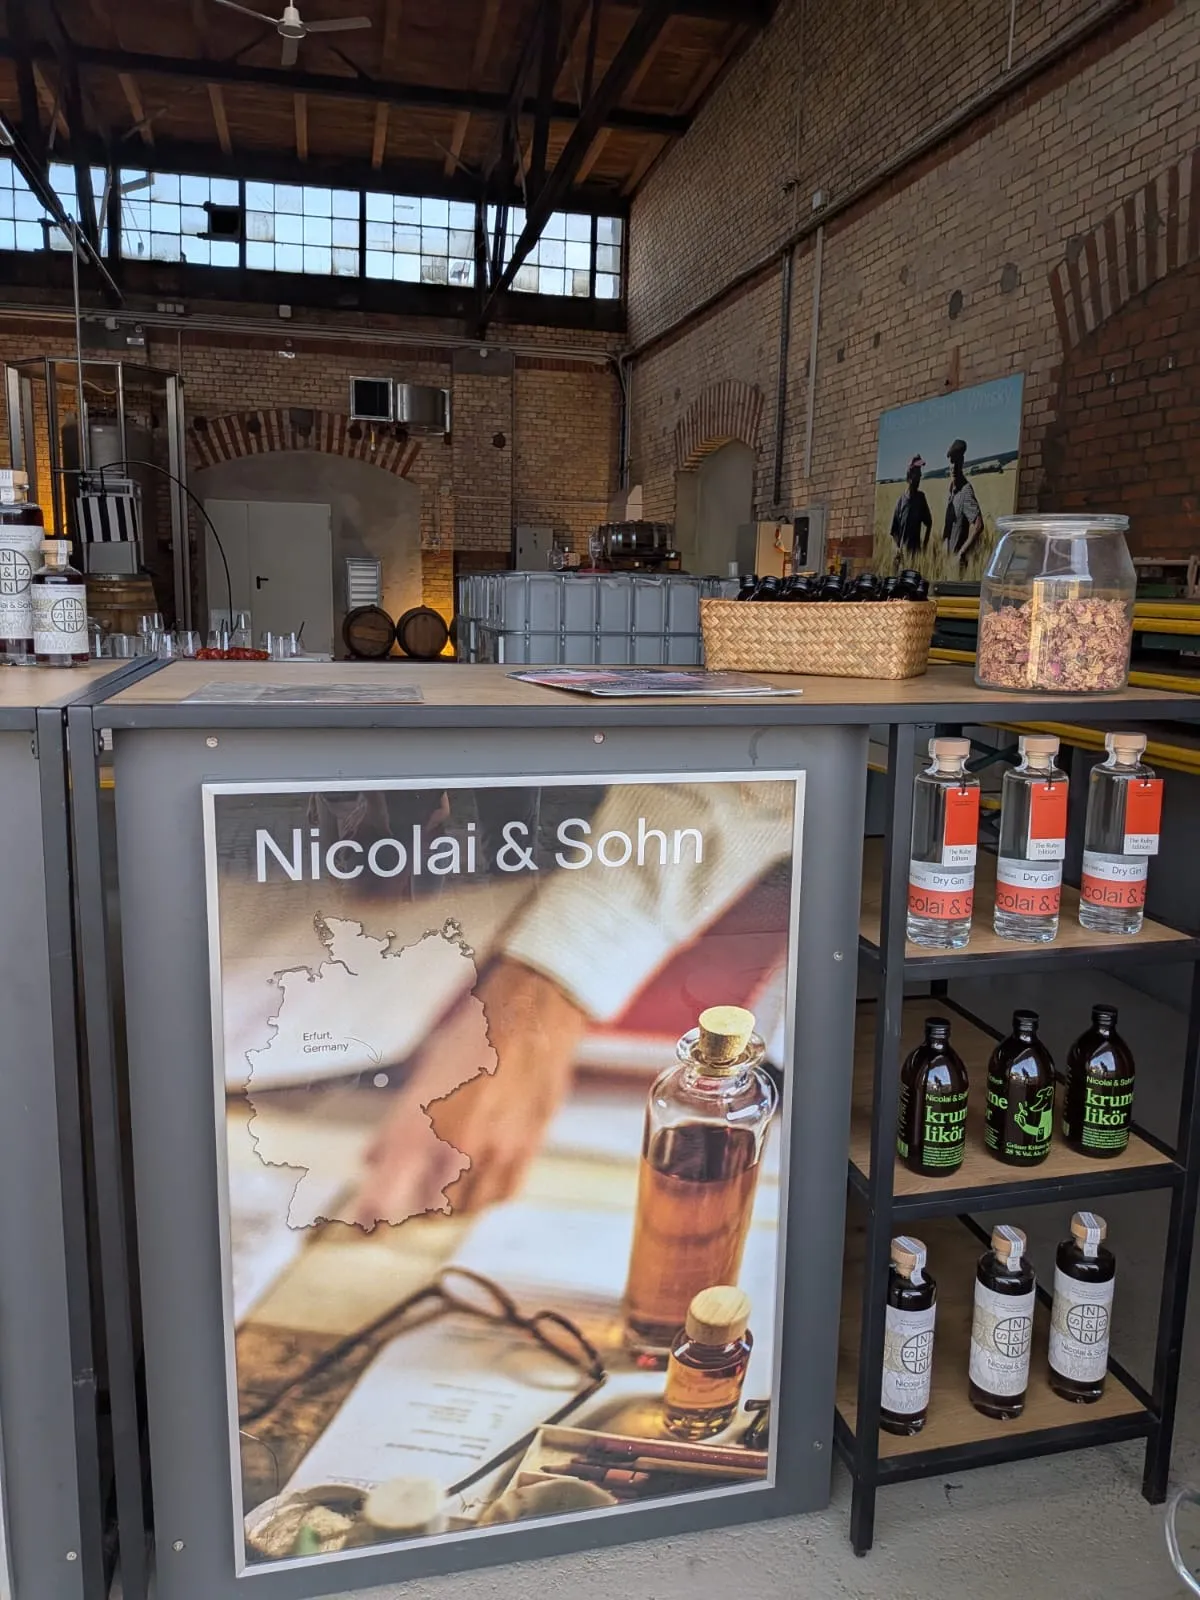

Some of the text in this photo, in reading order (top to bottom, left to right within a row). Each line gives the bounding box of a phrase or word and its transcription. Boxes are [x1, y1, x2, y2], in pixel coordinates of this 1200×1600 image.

[255, 817, 703, 882] Nicolai & Sohn
[1023, 872, 1039, 883] Dry
[1041, 873, 1054, 882] Gin
[1112, 866, 1128, 877] Dry
[1129, 867, 1142, 875] Gin
[933, 875, 949, 887] Dry
[950, 876, 965, 885] Gin
[1127, 888, 1138, 904] &
[949, 898, 961, 915] &
[1039, 895, 1050, 911] &
[303, 1031, 333, 1041] Erfurt,
[303, 1043, 349, 1053] Germany
[1086, 1075, 1112, 1087] Nicolai
[925, 1093, 951, 1103] Nicolai
[1084, 1105, 1127, 1126] likör
[924, 1124, 964, 1143] likör
